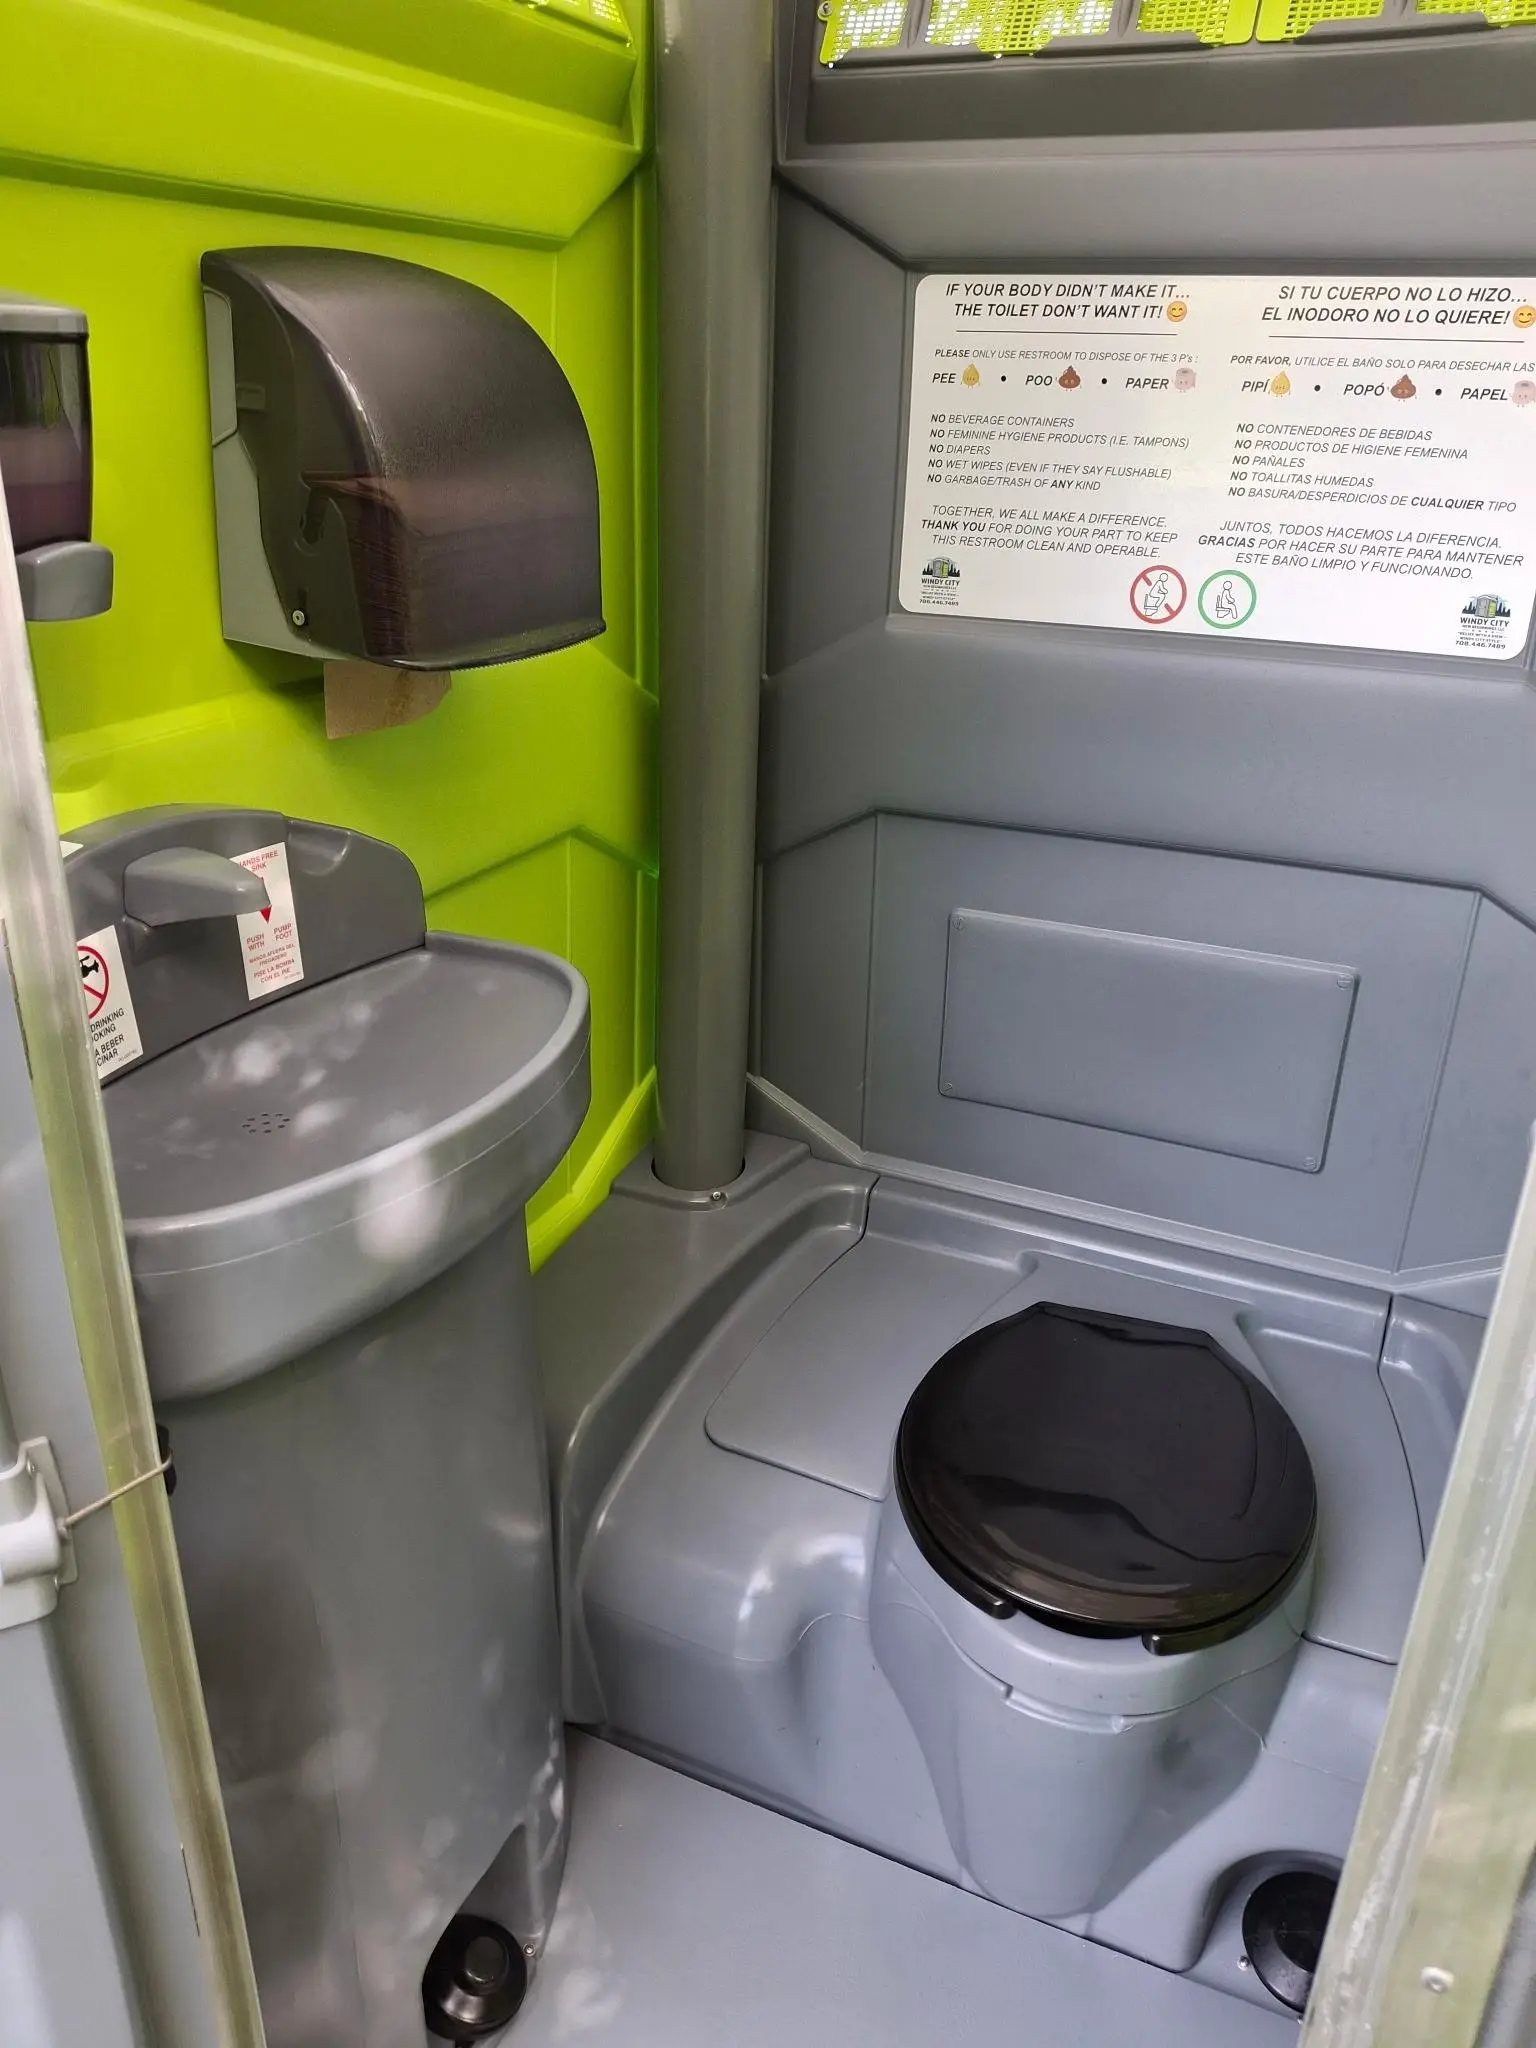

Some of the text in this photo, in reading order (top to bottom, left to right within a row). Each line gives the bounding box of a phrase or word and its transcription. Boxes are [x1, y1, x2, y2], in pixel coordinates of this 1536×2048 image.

[946, 283, 960, 296] IF
[964, 283, 1005, 297] YOUR
[1008, 284, 1053, 297] BODY
[1110, 284, 1158, 298] MAKE
[1278, 286, 1295, 300] SI
[1301, 286, 1323, 300] TU
[1327, 286, 1401, 301] CUERPO
[1405, 287, 1432, 301] NO
[1436, 288, 1463, 302] LO
[955, 303, 983, 316] THE
[987, 303, 1040, 317] TOILET
[1094, 305, 1141, 318] WANT
[1143, 305, 1163, 319] IT!
[1262, 307, 1511, 325] EL INODORO NO LO QUIERE!
[934, 349, 971, 359] PLEASE
[972, 349, 997, 359] ONLY
[998, 350, 1017, 359] USE
[1018, 350, 1073, 360] RESTROOM
[1074, 351, 1087, 361] TO
[1088, 352, 1132, 362] DISPOSE
[1133, 352, 1148, 362] OF
[1150, 353, 1170, 363] THE
[1170, 354, 1177, 363] 3
[1230, 355, 1536, 372] POR FAVOR, UTILICE EL BAÑO SOLO PARA DESECHAR LAS
[932, 372, 1170, 390] PEE POO PAPER
[1241, 380, 1508, 401] PIPÍ POPÓ PAPEL
[930, 414, 1075, 429] NO BEVERAGE CONTAINERS
[929, 428, 1190, 450] NO FEMININE HYGIENE PRODUCTS (I.E. TAMPONS)
[1236, 423, 1433, 441] NO CONTENEDORES DE BEBIDAS
[929, 444, 991, 456] NO DIAPERS
[1234, 439, 1468, 459] NO PRODUCTOS DE HIGIENE FEMENINA
[927, 458, 1172, 481] NO WET WIPES (EVEN IF THEY SAY FLUSHABLE)
[1232, 455, 1306, 468] NO PAÑALES
[927, 473, 1101, 491] NO GARBAGE/TRASH OF ANY KIND
[1230, 471, 1374, 488] NO TOALLITAS HUMEDAS
[1228, 487, 1517, 512] NO BASURA/DESPERDICIOS DE CUALQUIER TIPO
[999, 508, 1018, 520] WE
[1018, 510, 1040, 521] ALL
[1042, 511, 1077, 523] MAKE
[1077, 512, 1086, 523] A
[922, 519, 1178, 543] THANK YOU FOR DOING YOUR PART TO KEEP
[1219, 521, 1501, 548] JUNTOS, TODOS HACEMOS LA DIFERENCIA.
[933, 534, 958, 546] THIS
[959, 536, 1024, 549] RESTROOM
[1026, 539, 1066, 552] CLEAN
[1066, 542, 1092, 554] AND
[1198, 534, 1524, 566] GRACIAS POR HACER SU PARTE PARA MANTENER
[1235, 552, 1473, 579] ESTE BAÑO LIMPIO Y FUNCIONANDO.
[262, 850, 278, 861] FREE
[252, 862, 267, 872] SINK
[246, 923, 292, 944] PUSH PUMP
[248, 930, 293, 951] WITH FOOT
[254, 969, 265, 978] PISE
[275, 958, 295, 971] BOMBA
[261, 974, 272, 983] CON
[90, 1008, 125, 1033] DRINKING
[101, 1034, 125, 1053] BEBER
